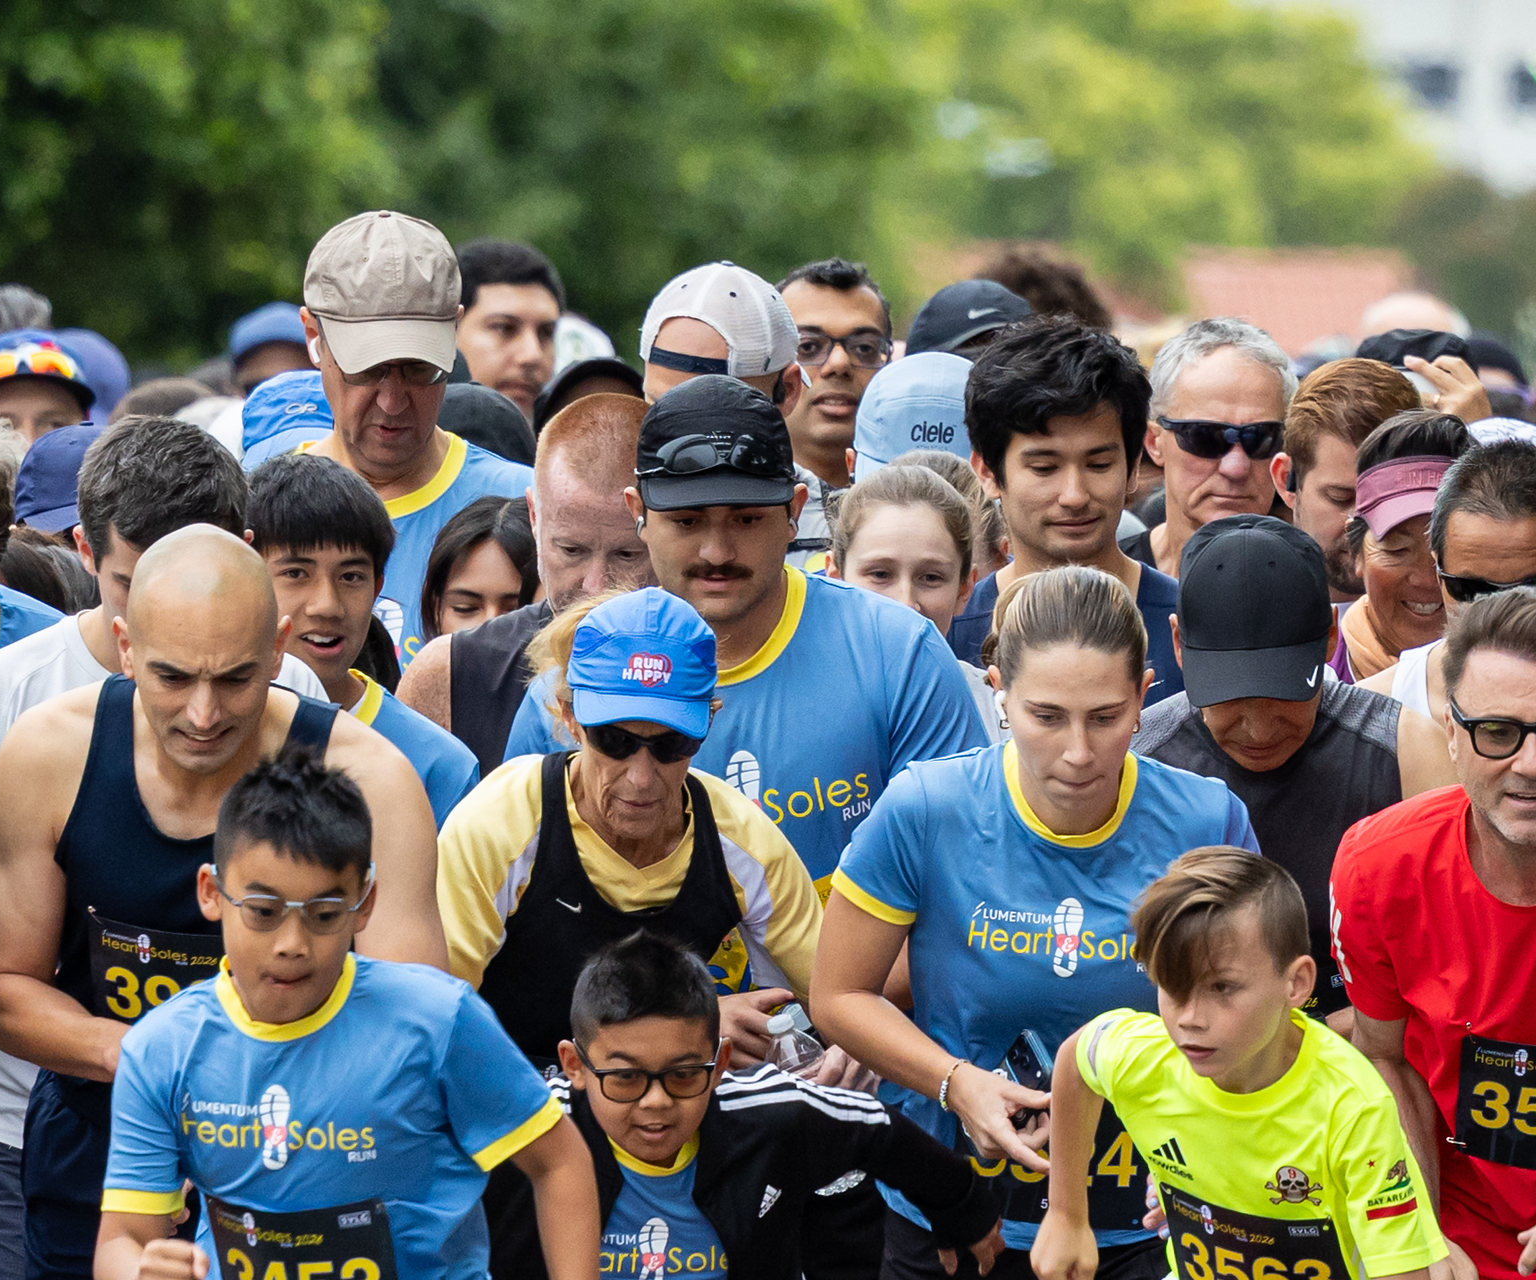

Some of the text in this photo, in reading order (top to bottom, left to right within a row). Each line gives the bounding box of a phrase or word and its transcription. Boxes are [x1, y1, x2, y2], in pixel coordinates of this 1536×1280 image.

[911, 421, 954, 444] ciele
[632, 656, 664, 671] RUN
[622, 668, 672, 684] HAPPY
[763, 773, 869, 825] Soles
[842, 798, 873, 823] RUN
[983, 909, 1053, 926] LUMENTUM
[967, 919, 1056, 953] Heart
[150, 946, 189, 963] Soles
[1475, 1053, 1515, 1068] Heart
[191, 1100, 259, 1117] UMENTUM
[288, 1119, 376, 1152] Soles
[667, 1246, 729, 1273] Sole
